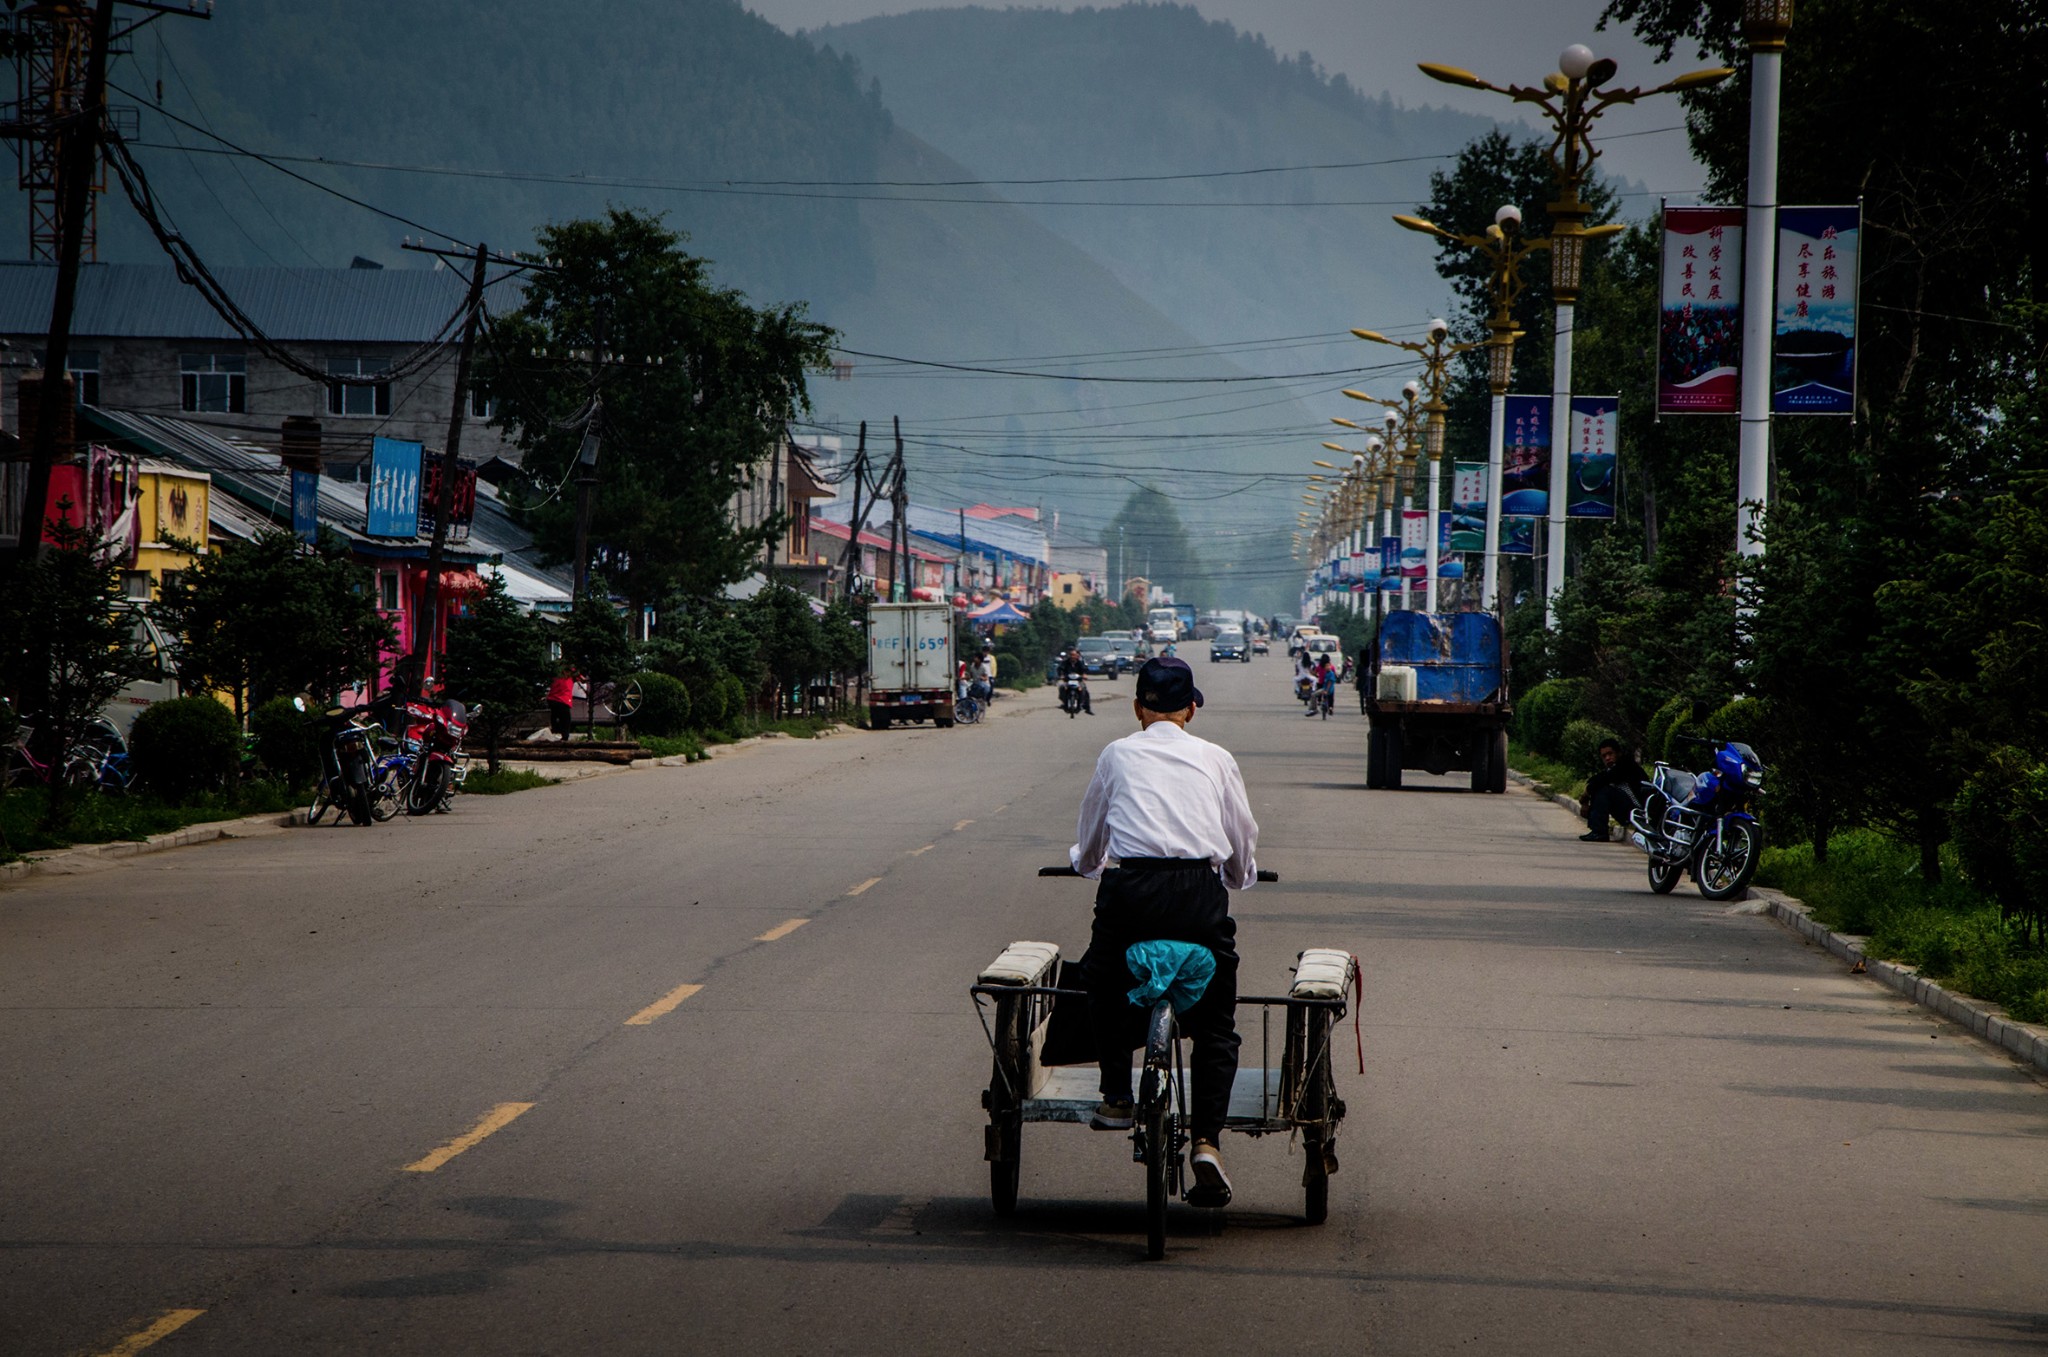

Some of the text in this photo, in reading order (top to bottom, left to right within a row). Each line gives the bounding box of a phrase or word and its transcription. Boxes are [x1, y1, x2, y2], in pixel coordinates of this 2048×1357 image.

[1681, 244, 1698, 318] 改善民生
[1707, 225, 1724, 300] 科学发展
[1795, 243, 1813, 318] 尽享健康
[1821, 225, 1839, 300] 欢乐旅游
